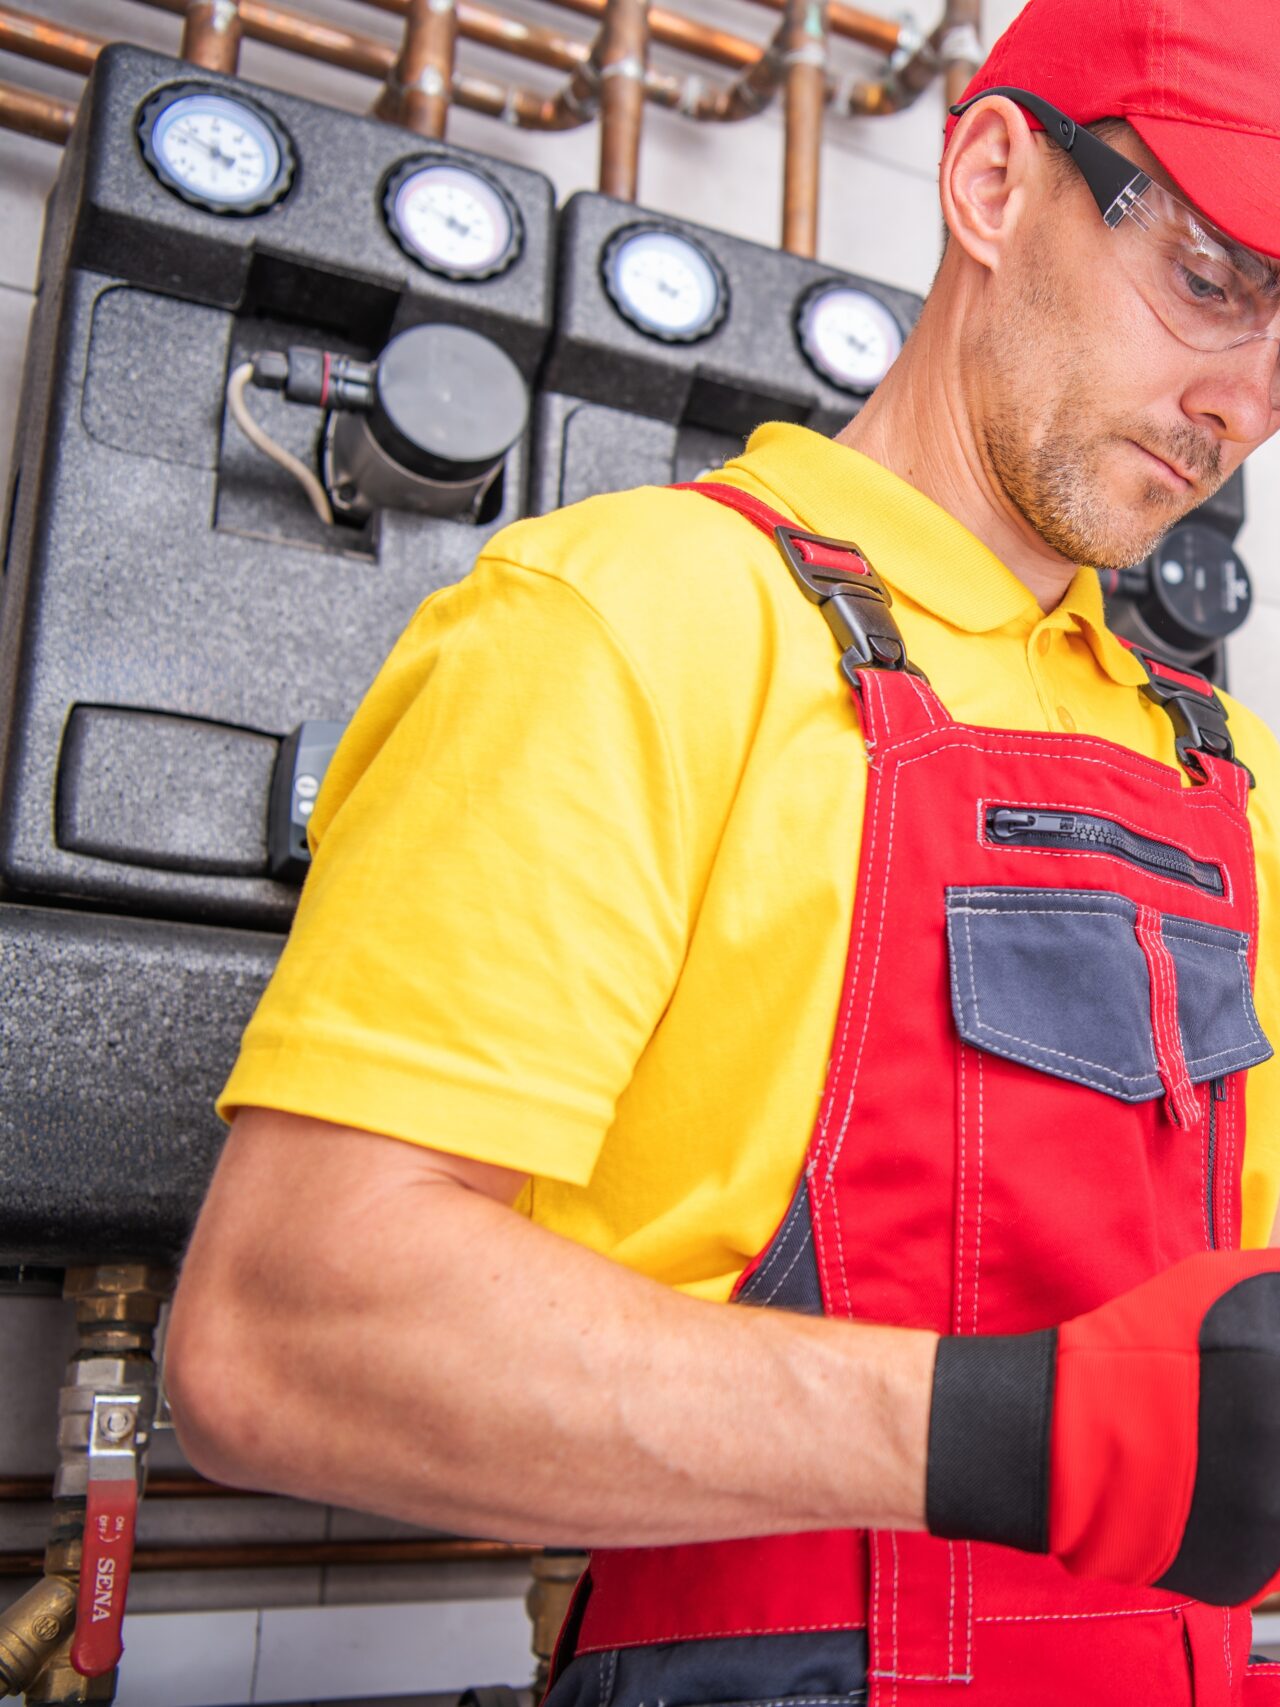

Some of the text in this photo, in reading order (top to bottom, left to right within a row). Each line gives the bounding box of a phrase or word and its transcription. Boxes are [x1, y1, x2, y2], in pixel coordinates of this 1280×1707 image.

[98, 1515, 109, 1534] OFF
[115, 1516, 125, 1531] ON
[92, 1557, 116, 1622] SENA
